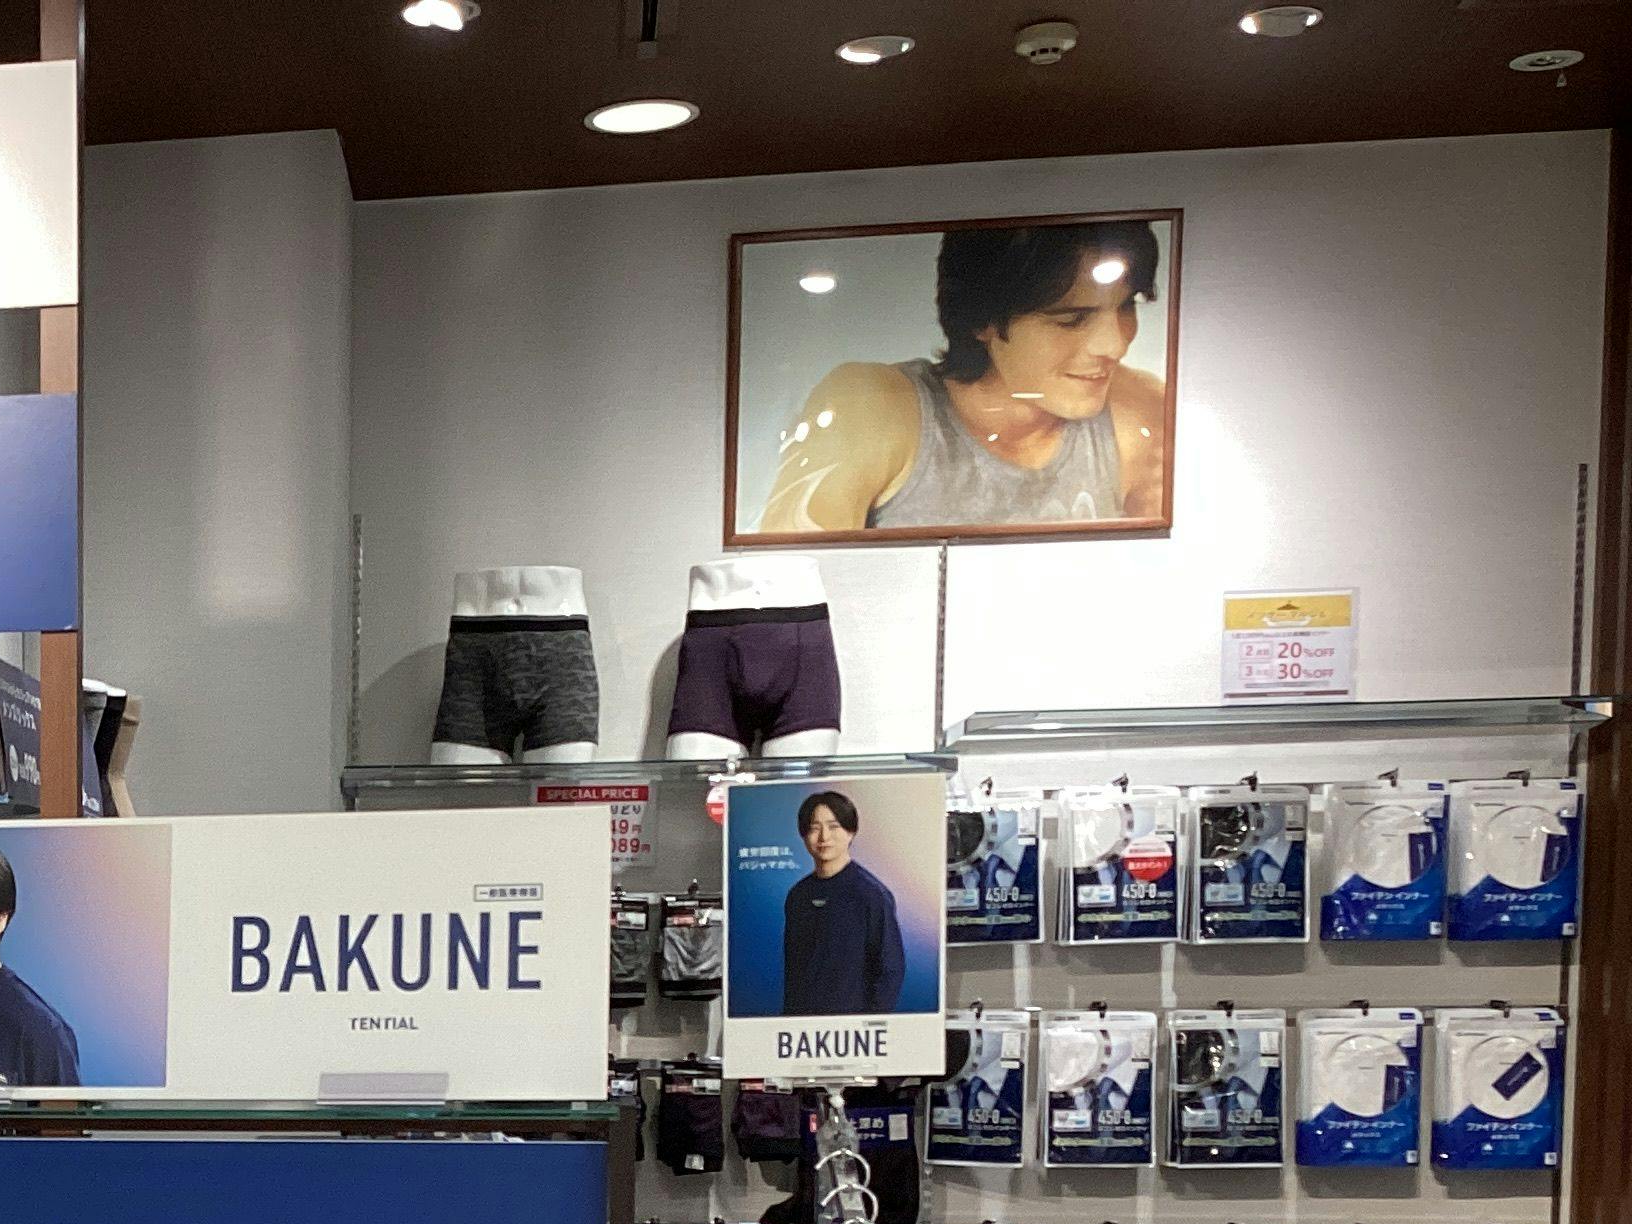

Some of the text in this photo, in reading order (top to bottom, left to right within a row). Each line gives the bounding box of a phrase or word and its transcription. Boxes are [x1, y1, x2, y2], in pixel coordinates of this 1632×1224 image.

[546, 788, 639, 799] SPECIAL PRICE
[231, 911, 543, 992] BAKUNE
[349, 1017, 419, 1030] TENTIAL
[778, 1029, 887, 1059] BAKUNE
